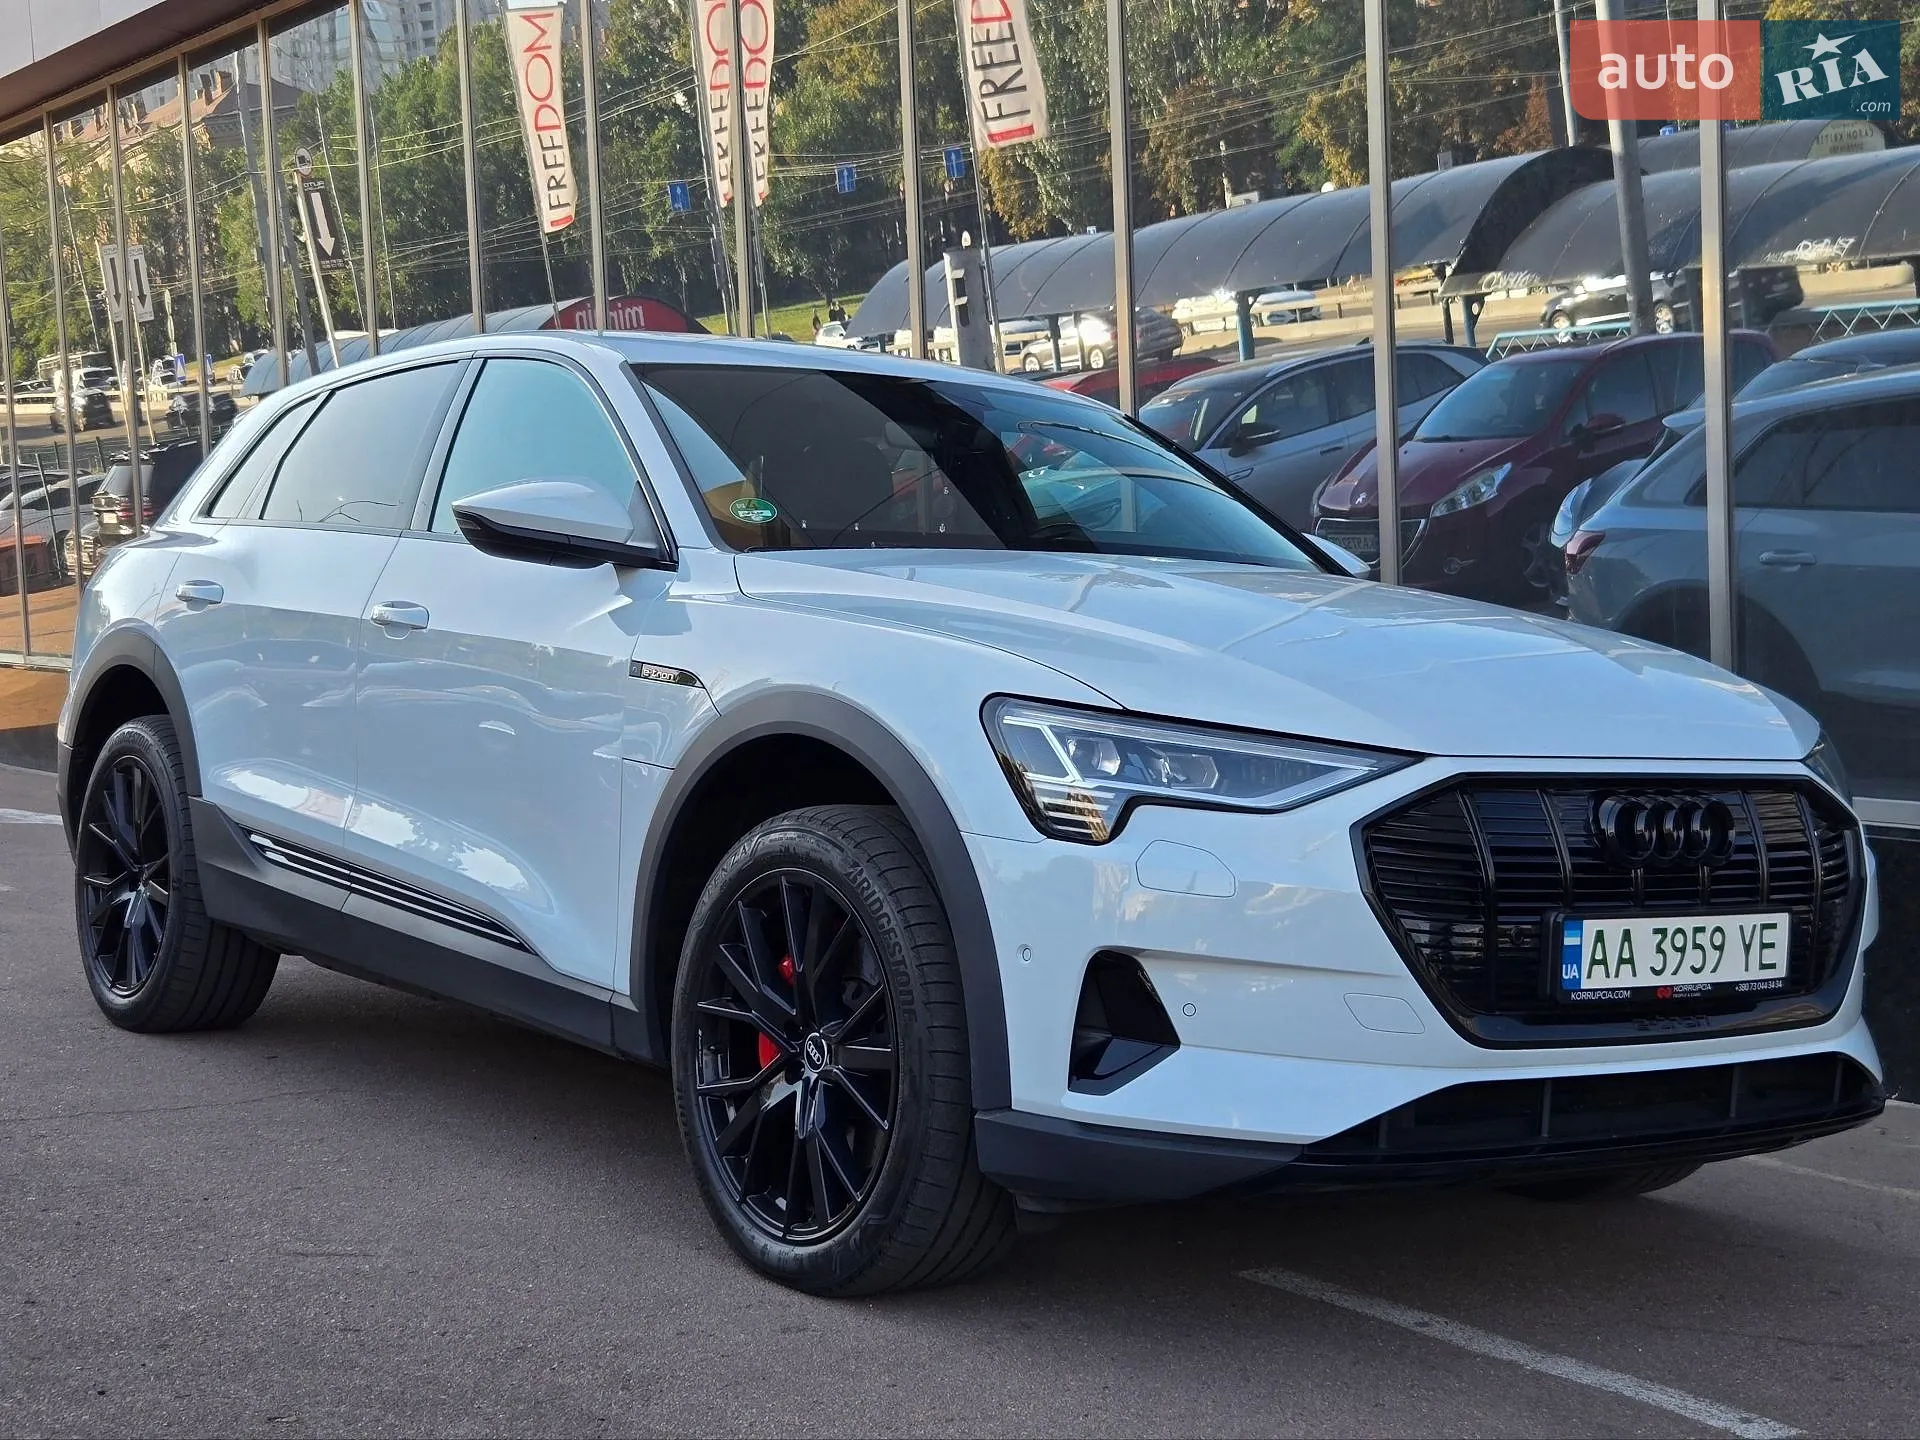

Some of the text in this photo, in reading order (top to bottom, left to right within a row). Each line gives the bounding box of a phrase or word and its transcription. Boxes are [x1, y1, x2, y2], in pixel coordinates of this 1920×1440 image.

[520, 12, 571, 212] FREEDOM
[643, 668, 674, 681] e-tron
[844, 858, 918, 1023] BRIDGESTONE
[1586, 922, 1778, 980] AA 3959 YE
[1562, 963, 1579, 979] UA
